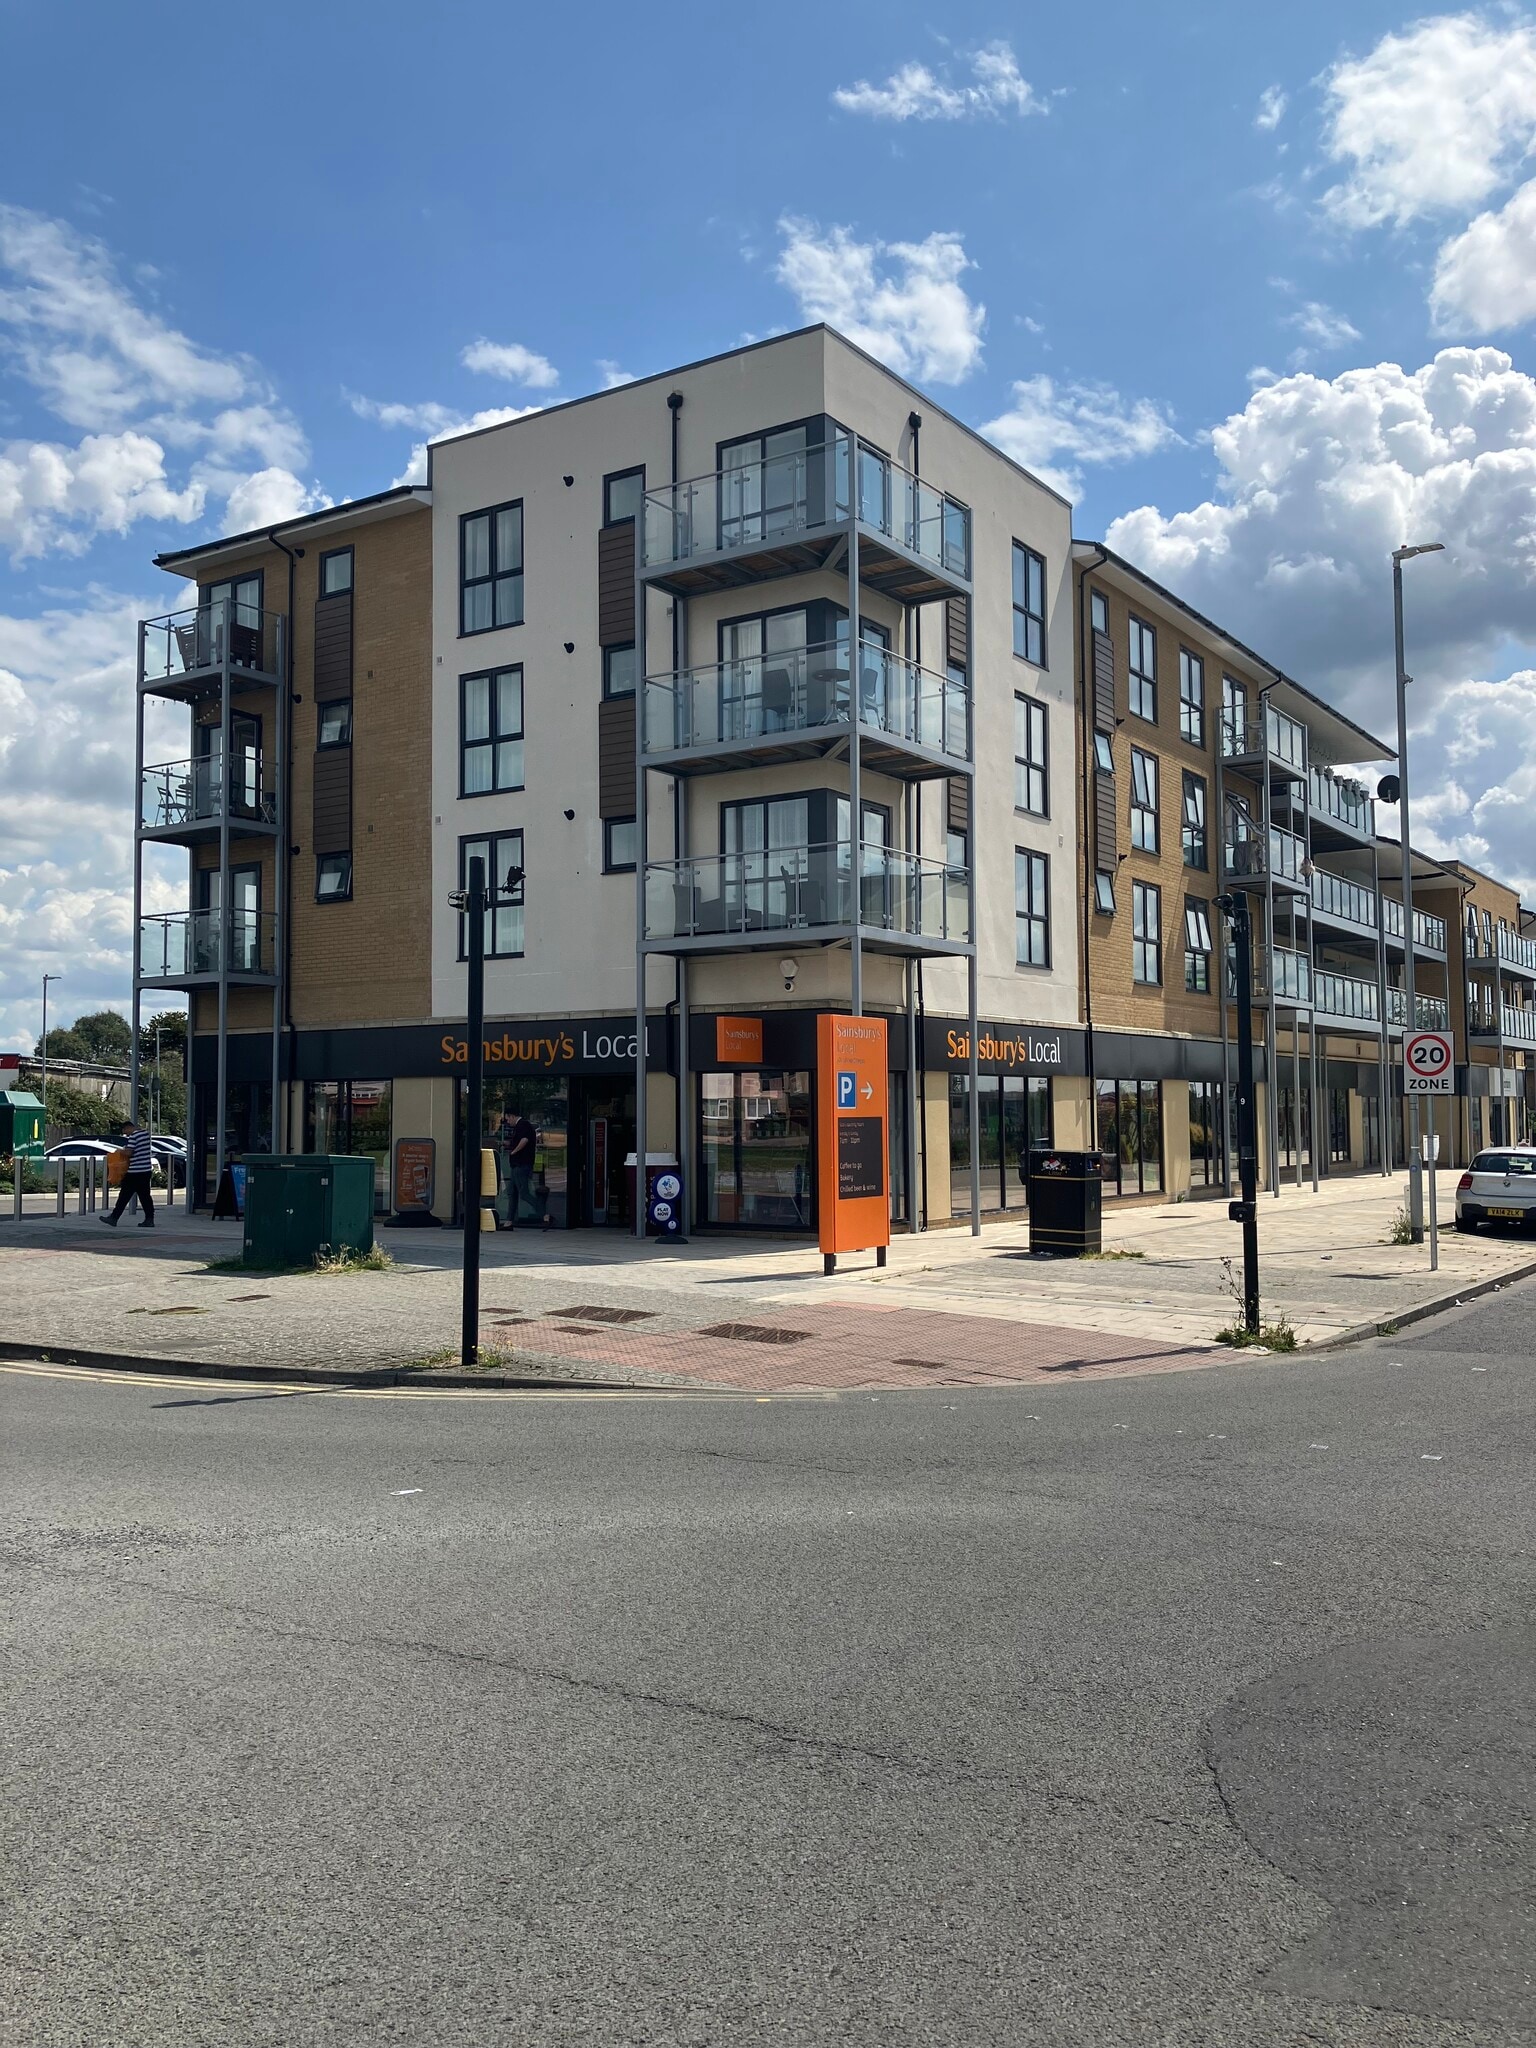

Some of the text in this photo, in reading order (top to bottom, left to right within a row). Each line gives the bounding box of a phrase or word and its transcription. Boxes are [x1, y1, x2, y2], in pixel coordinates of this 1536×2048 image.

[836, 1023, 882, 1042] Sainsbury's
[441, 1026, 650, 1067] Sansbury's Local
[947, 1030, 1061, 1067] Saisbury's Local
[1414, 1047, 1444, 1064] 20
[841, 1076, 853, 1104] P
[1409, 1079, 1449, 1089] ZONE
[1240, 1097, 1246, 1105] 9
[839, 1162, 852, 1170] Coffee
[857, 1162, 862, 1170] go
[839, 1174, 854, 1182] Bakery
[839, 1185, 853, 1193] Chilled
